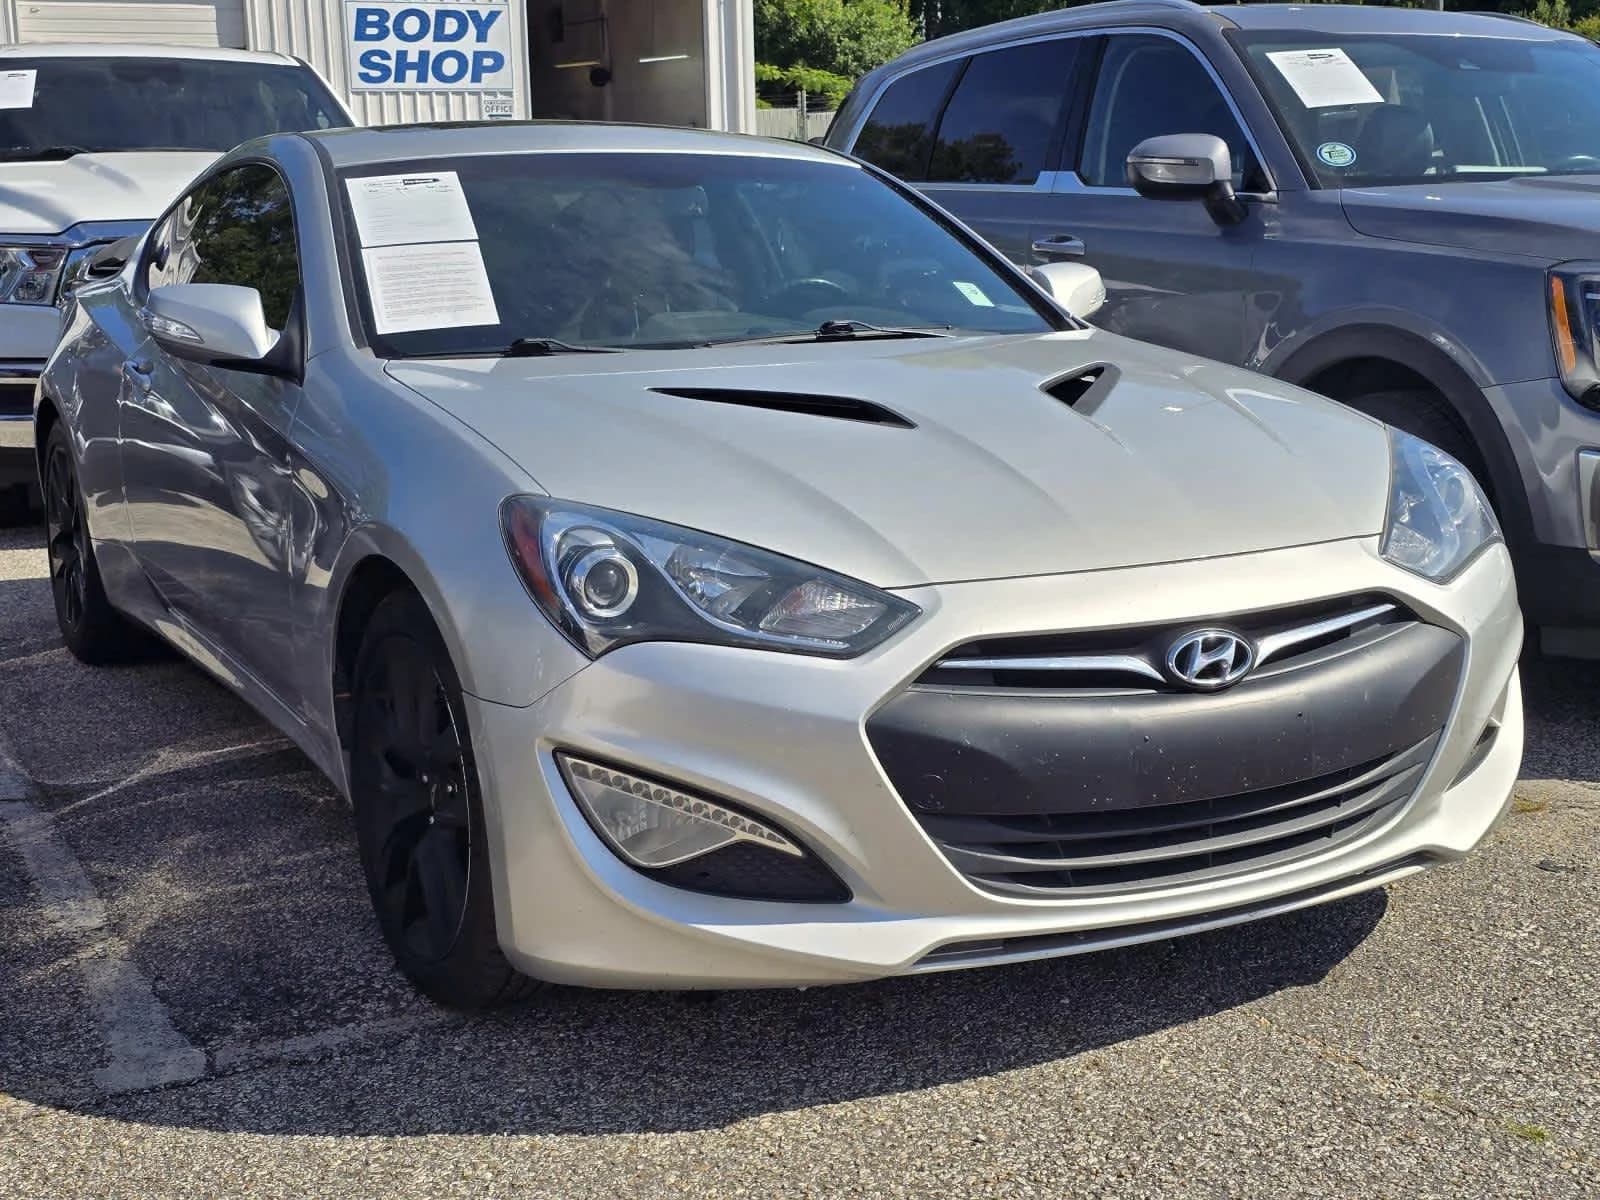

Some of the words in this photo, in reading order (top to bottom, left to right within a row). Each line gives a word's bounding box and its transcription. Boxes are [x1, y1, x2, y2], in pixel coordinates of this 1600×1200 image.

[354, 8, 503, 43] BODY
[358, 49, 505, 84] SHOP
[484, 105, 513, 113] OFFICE
